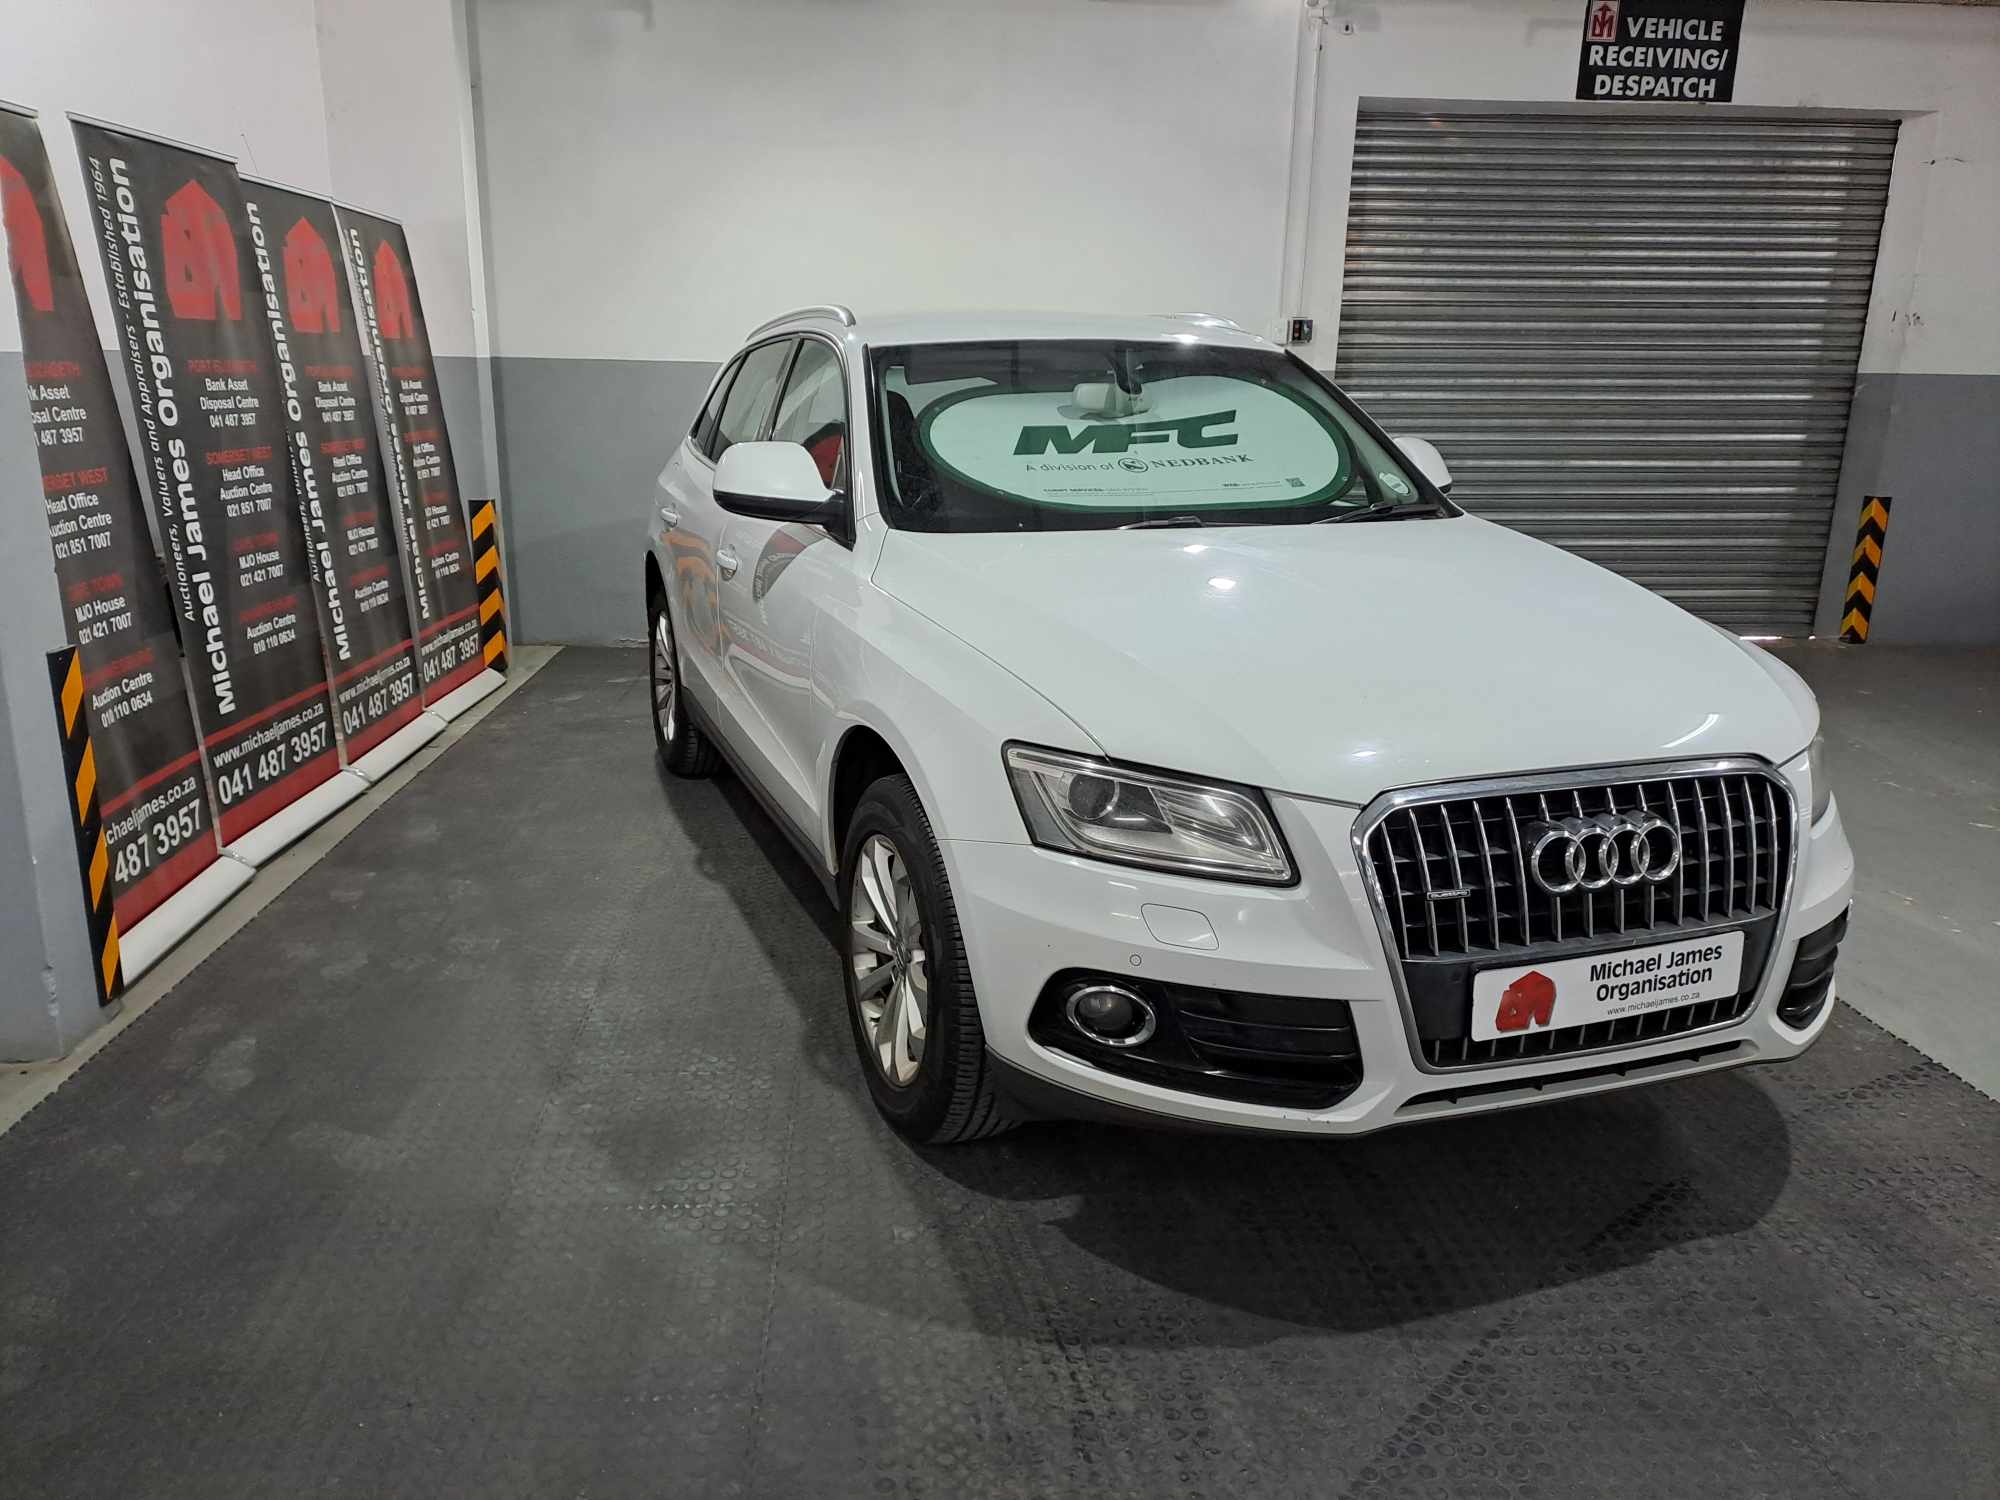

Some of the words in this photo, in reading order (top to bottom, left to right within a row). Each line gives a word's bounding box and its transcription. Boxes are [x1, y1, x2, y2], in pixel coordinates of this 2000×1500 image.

[1627, 17, 1724, 41] VEHICLE
[1588, 44, 1729, 71] RECEIVING/
[1593, 75, 1717, 99] DESPATCH
[88, 156, 108, 202] 1964
[98, 206, 131, 309] Established
[109, 158, 179, 427] Organisation
[246, 202, 302, 422] Organisation
[125, 324, 153, 416] Appraisers
[205, 378, 226, 391] Bank
[227, 378, 249, 391] Asset
[40, 384, 71, 401] Asset
[200, 396, 236, 412] Disposal
[236, 396, 260, 409] Centre
[52, 406, 88, 422] Centre
[209, 414, 224, 428] 041
[224, 413, 239, 427] 487
[41, 429, 58, 446] 487
[59, 427, 84, 444] 3957
[144, 418, 160, 452] and
[1013, 409, 1239, 456] MFC
[222, 467, 243, 482] Head
[242, 465, 265, 479] Office
[1026, 462, 1037, 472] A
[1040, 461, 1097, 473] division
[1100, 462, 1115, 472] of
[1151, 453, 1255, 469] NEDBANK
[154, 456, 174, 517] Valuers
[220, 485, 249, 501] Auction
[249, 482, 273, 496] Centre
[295, 431, 326, 534] James
[68, 493, 100, 510] Office
[168, 438, 207, 561] James
[226, 504, 240, 518] 021
[240, 501, 255, 516] 851
[79, 512, 113, 530] Centre
[55, 543, 71, 560] 021
[69, 537, 88, 555] 851
[88, 531, 112, 550] 7007
[255, 551, 281, 565] House
[168, 523, 196, 622] Auctioneers,
[240, 575, 253, 588] 021
[253, 569, 267, 583] 421
[267, 564, 285, 580] 7007
[75, 603, 94, 624] MJO
[94, 596, 127, 616] House
[316, 542, 351, 661] Michael
[78, 629, 93, 645] 021
[93, 619, 109, 639] 421
[110, 612, 133, 632] 7007
[246, 621, 273, 640] Auction
[272, 612, 297, 630] Centre
[192, 571, 237, 716] Michael
[422, 656, 441, 683] 041
[441, 645, 457, 672] 487
[458, 632, 480, 661] 3957
[92, 685, 121, 711] Auction
[121, 671, 153, 694] Centre
[113, 701, 130, 720] 110
[130, 690, 153, 712] 0634
[343, 702, 367, 735] 041
[368, 688, 388, 719] 487
[389, 672, 414, 706] 3957
[213, 702, 325, 769] www.michaeljames.co.za
[218, 762, 254, 806] 041
[257, 743, 287, 782] 487
[290, 721, 328, 764] 3957
[114, 833, 151, 884] 487
[152, 798, 202, 856] 3957
[1589, 953, 1663, 983] Michael
[1666, 944, 1723, 970] James
[1596, 966, 1713, 1002] Organisation
